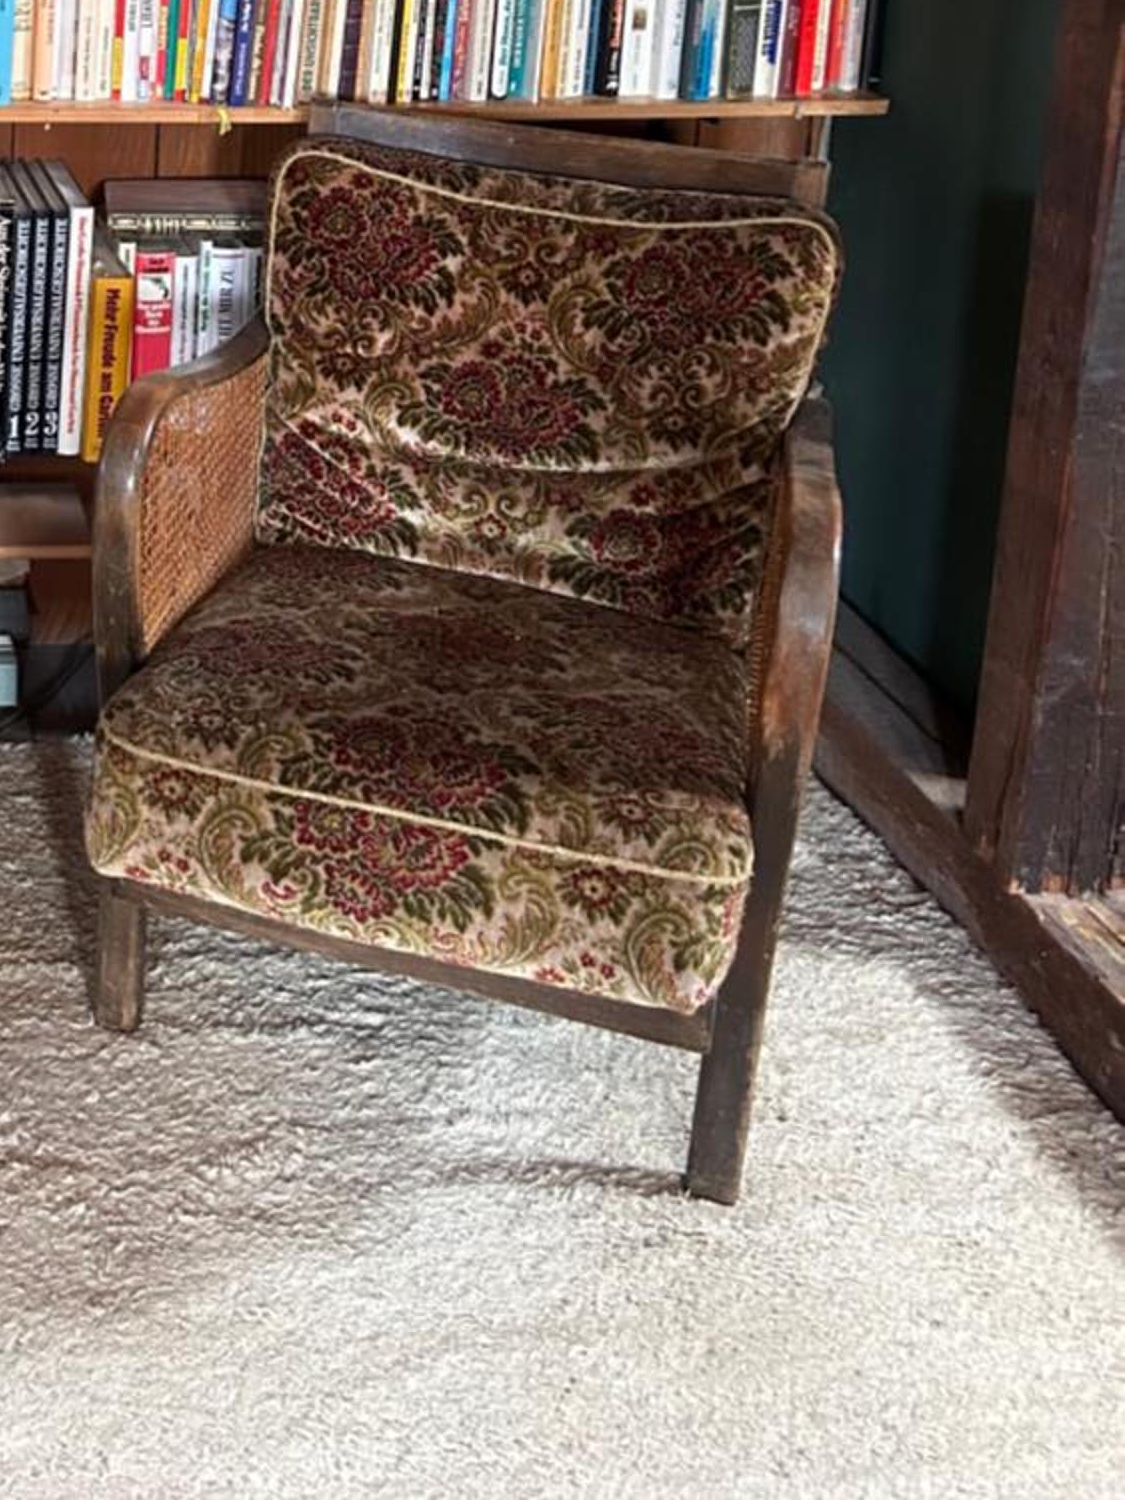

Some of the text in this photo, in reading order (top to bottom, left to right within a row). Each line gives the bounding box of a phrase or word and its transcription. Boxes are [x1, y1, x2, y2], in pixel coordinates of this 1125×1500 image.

[104, 286, 121, 322] Mehr
[9, 414, 19, 438] 1
[25, 412, 39, 437] 2
[43, 412, 57, 436] 3
